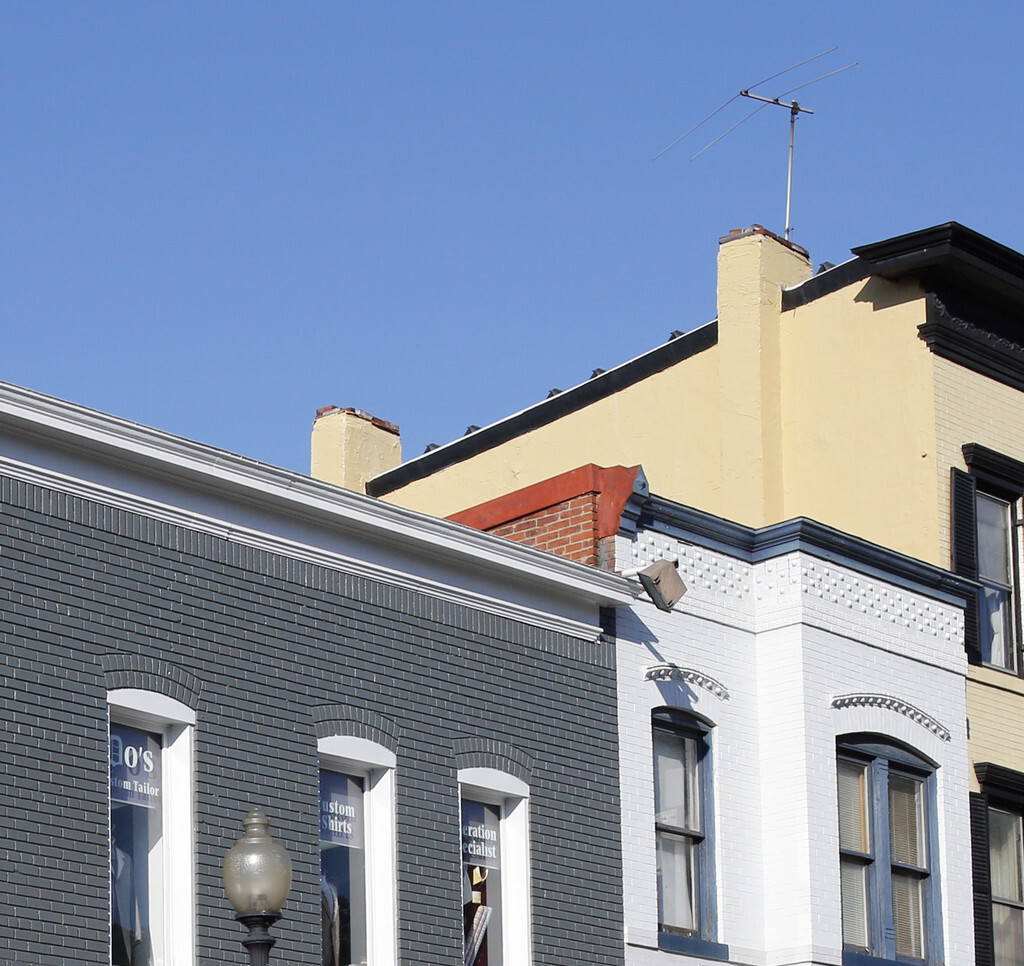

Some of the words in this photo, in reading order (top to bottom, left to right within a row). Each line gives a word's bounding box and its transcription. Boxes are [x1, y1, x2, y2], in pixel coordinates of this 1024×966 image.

[111, 777, 131, 790] stom
[133, 780, 159, 797] Tailor
[322, 800, 355, 818] ustom
[321, 815, 352, 834] Shirts
[463, 824, 497, 841] eration
[463, 840, 496, 858] ecialist
